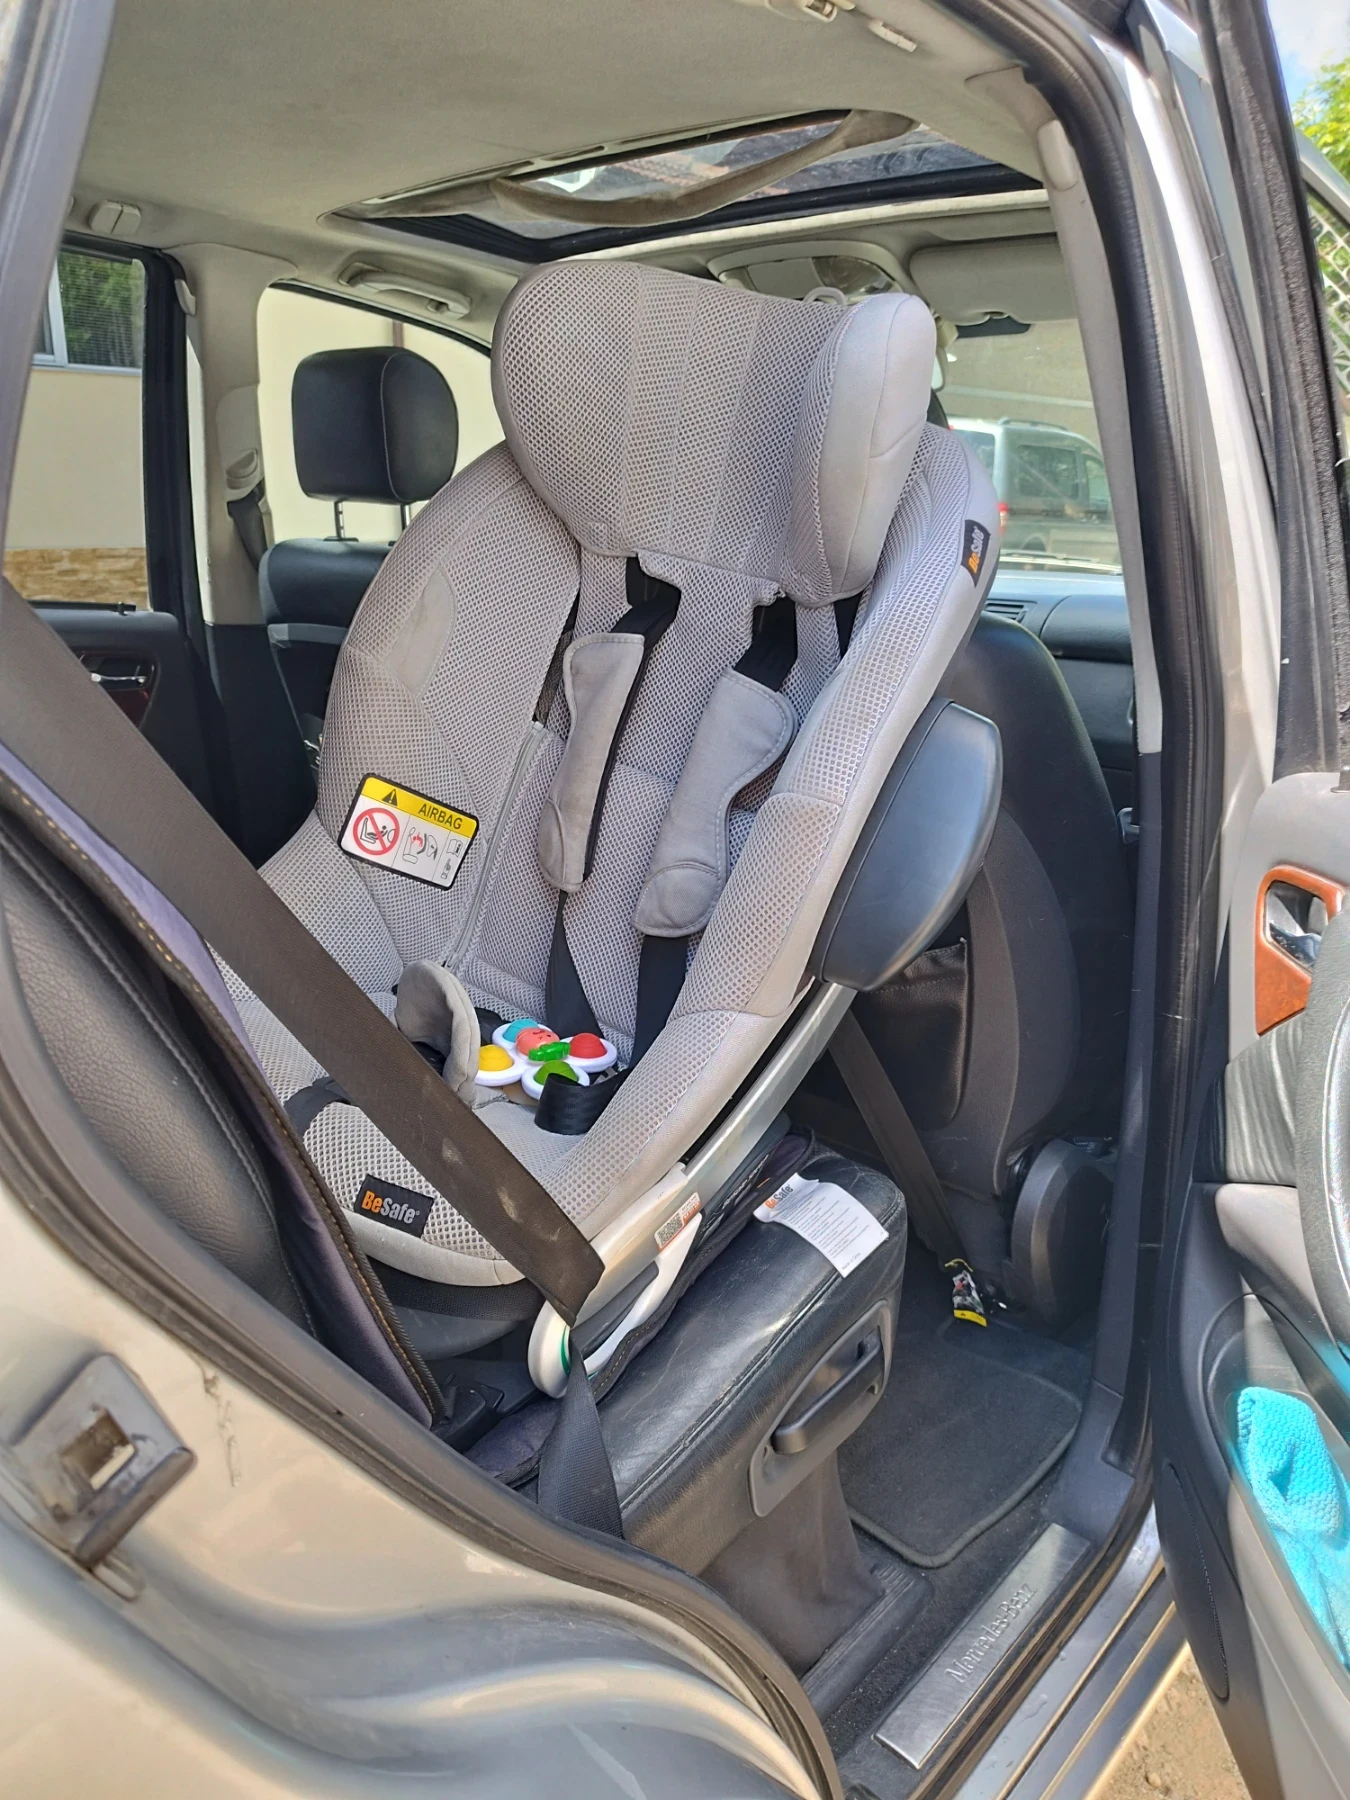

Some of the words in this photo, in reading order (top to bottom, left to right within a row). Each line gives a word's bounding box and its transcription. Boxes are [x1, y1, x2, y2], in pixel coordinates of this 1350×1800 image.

[418, 803, 463, 830] AIRBAG
[361, 1190, 416, 1224] BeSafe
[765, 1185, 793, 1209] BeSafe
[944, 1583, 1037, 1683] Mercedes-Benz
